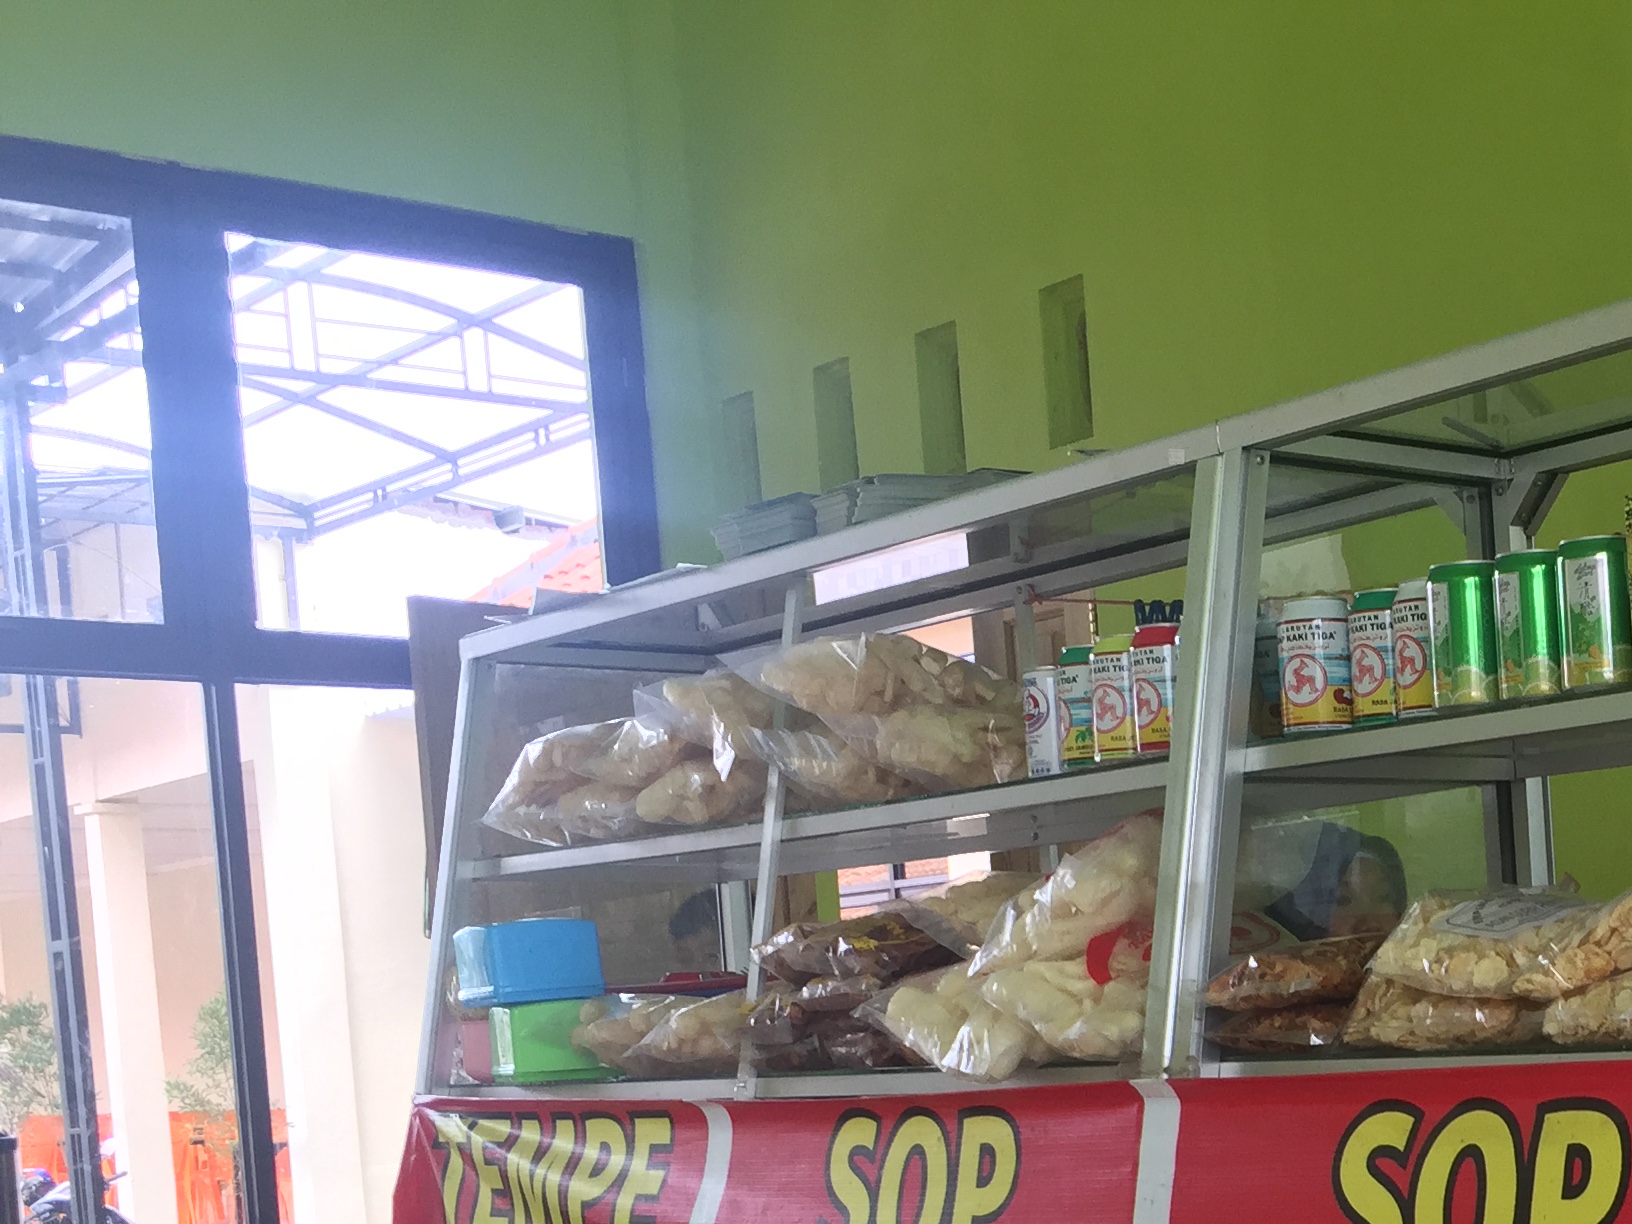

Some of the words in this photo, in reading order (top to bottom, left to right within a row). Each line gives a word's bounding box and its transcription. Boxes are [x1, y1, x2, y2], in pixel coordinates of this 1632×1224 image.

[1411, 613, 1427, 622] TIG
[1369, 621, 1394, 631] TIGA
[1286, 632, 1308, 642] KAKI
[1310, 631, 1335, 641] TIGA
